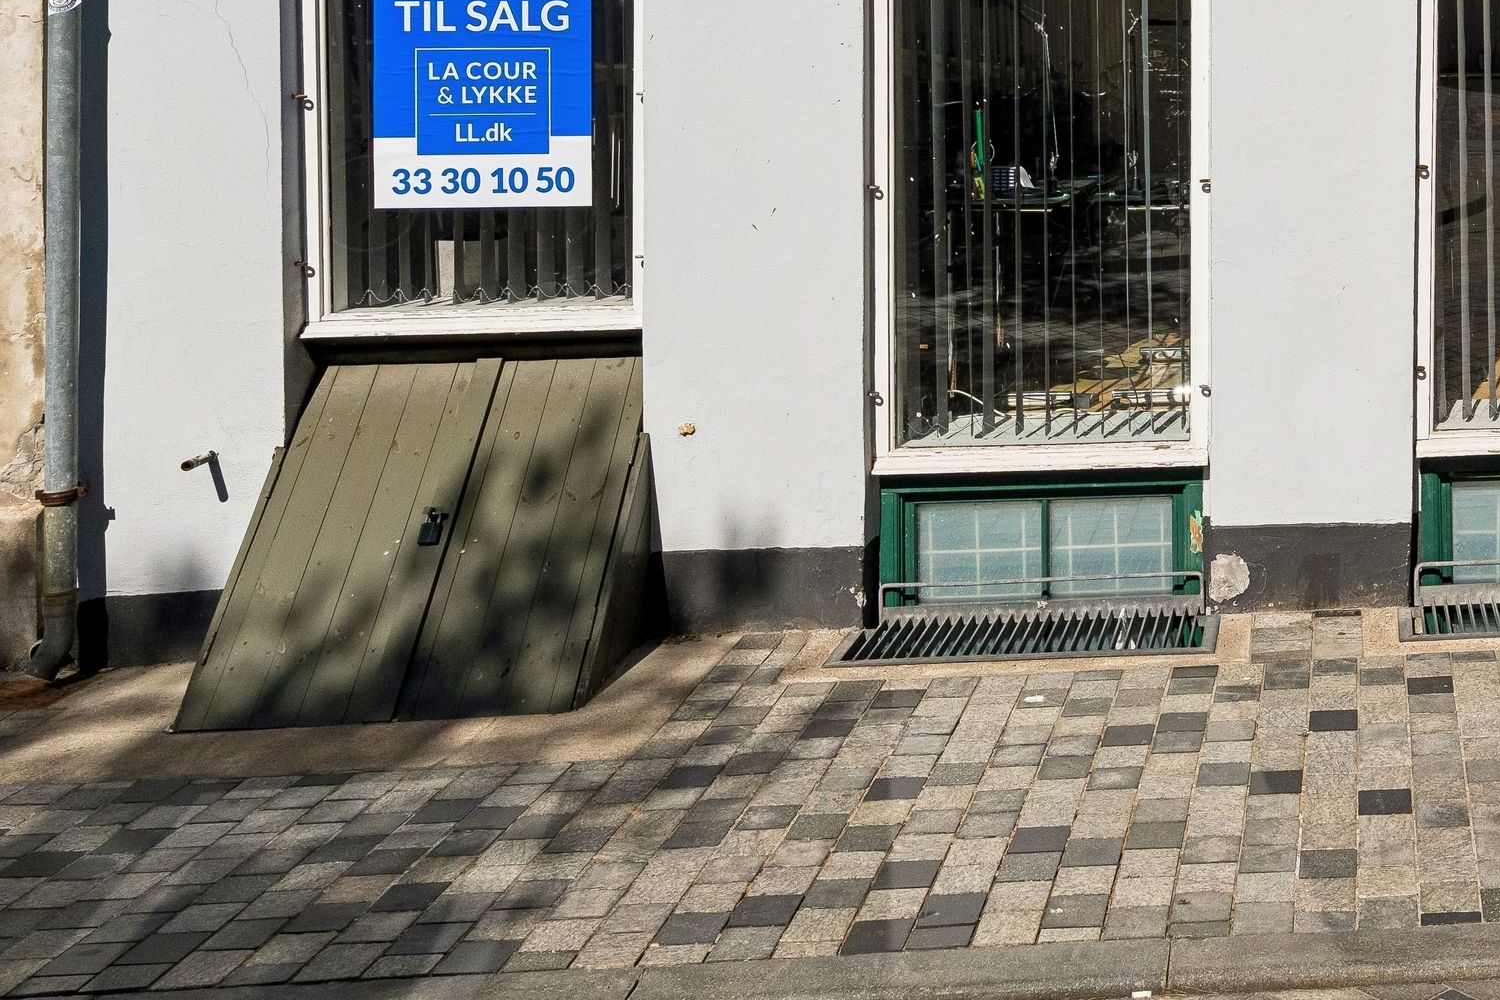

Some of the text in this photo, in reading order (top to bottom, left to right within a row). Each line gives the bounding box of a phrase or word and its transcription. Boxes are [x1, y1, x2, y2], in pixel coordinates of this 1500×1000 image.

[395, 0, 569, 31] TIL SALG
[429, 62, 536, 80] LA COUR
[438, 86, 536, 104] & LYKKE
[456, 123, 512, 141] LL.dk
[392, 167, 574, 194] 33 30 10 50
